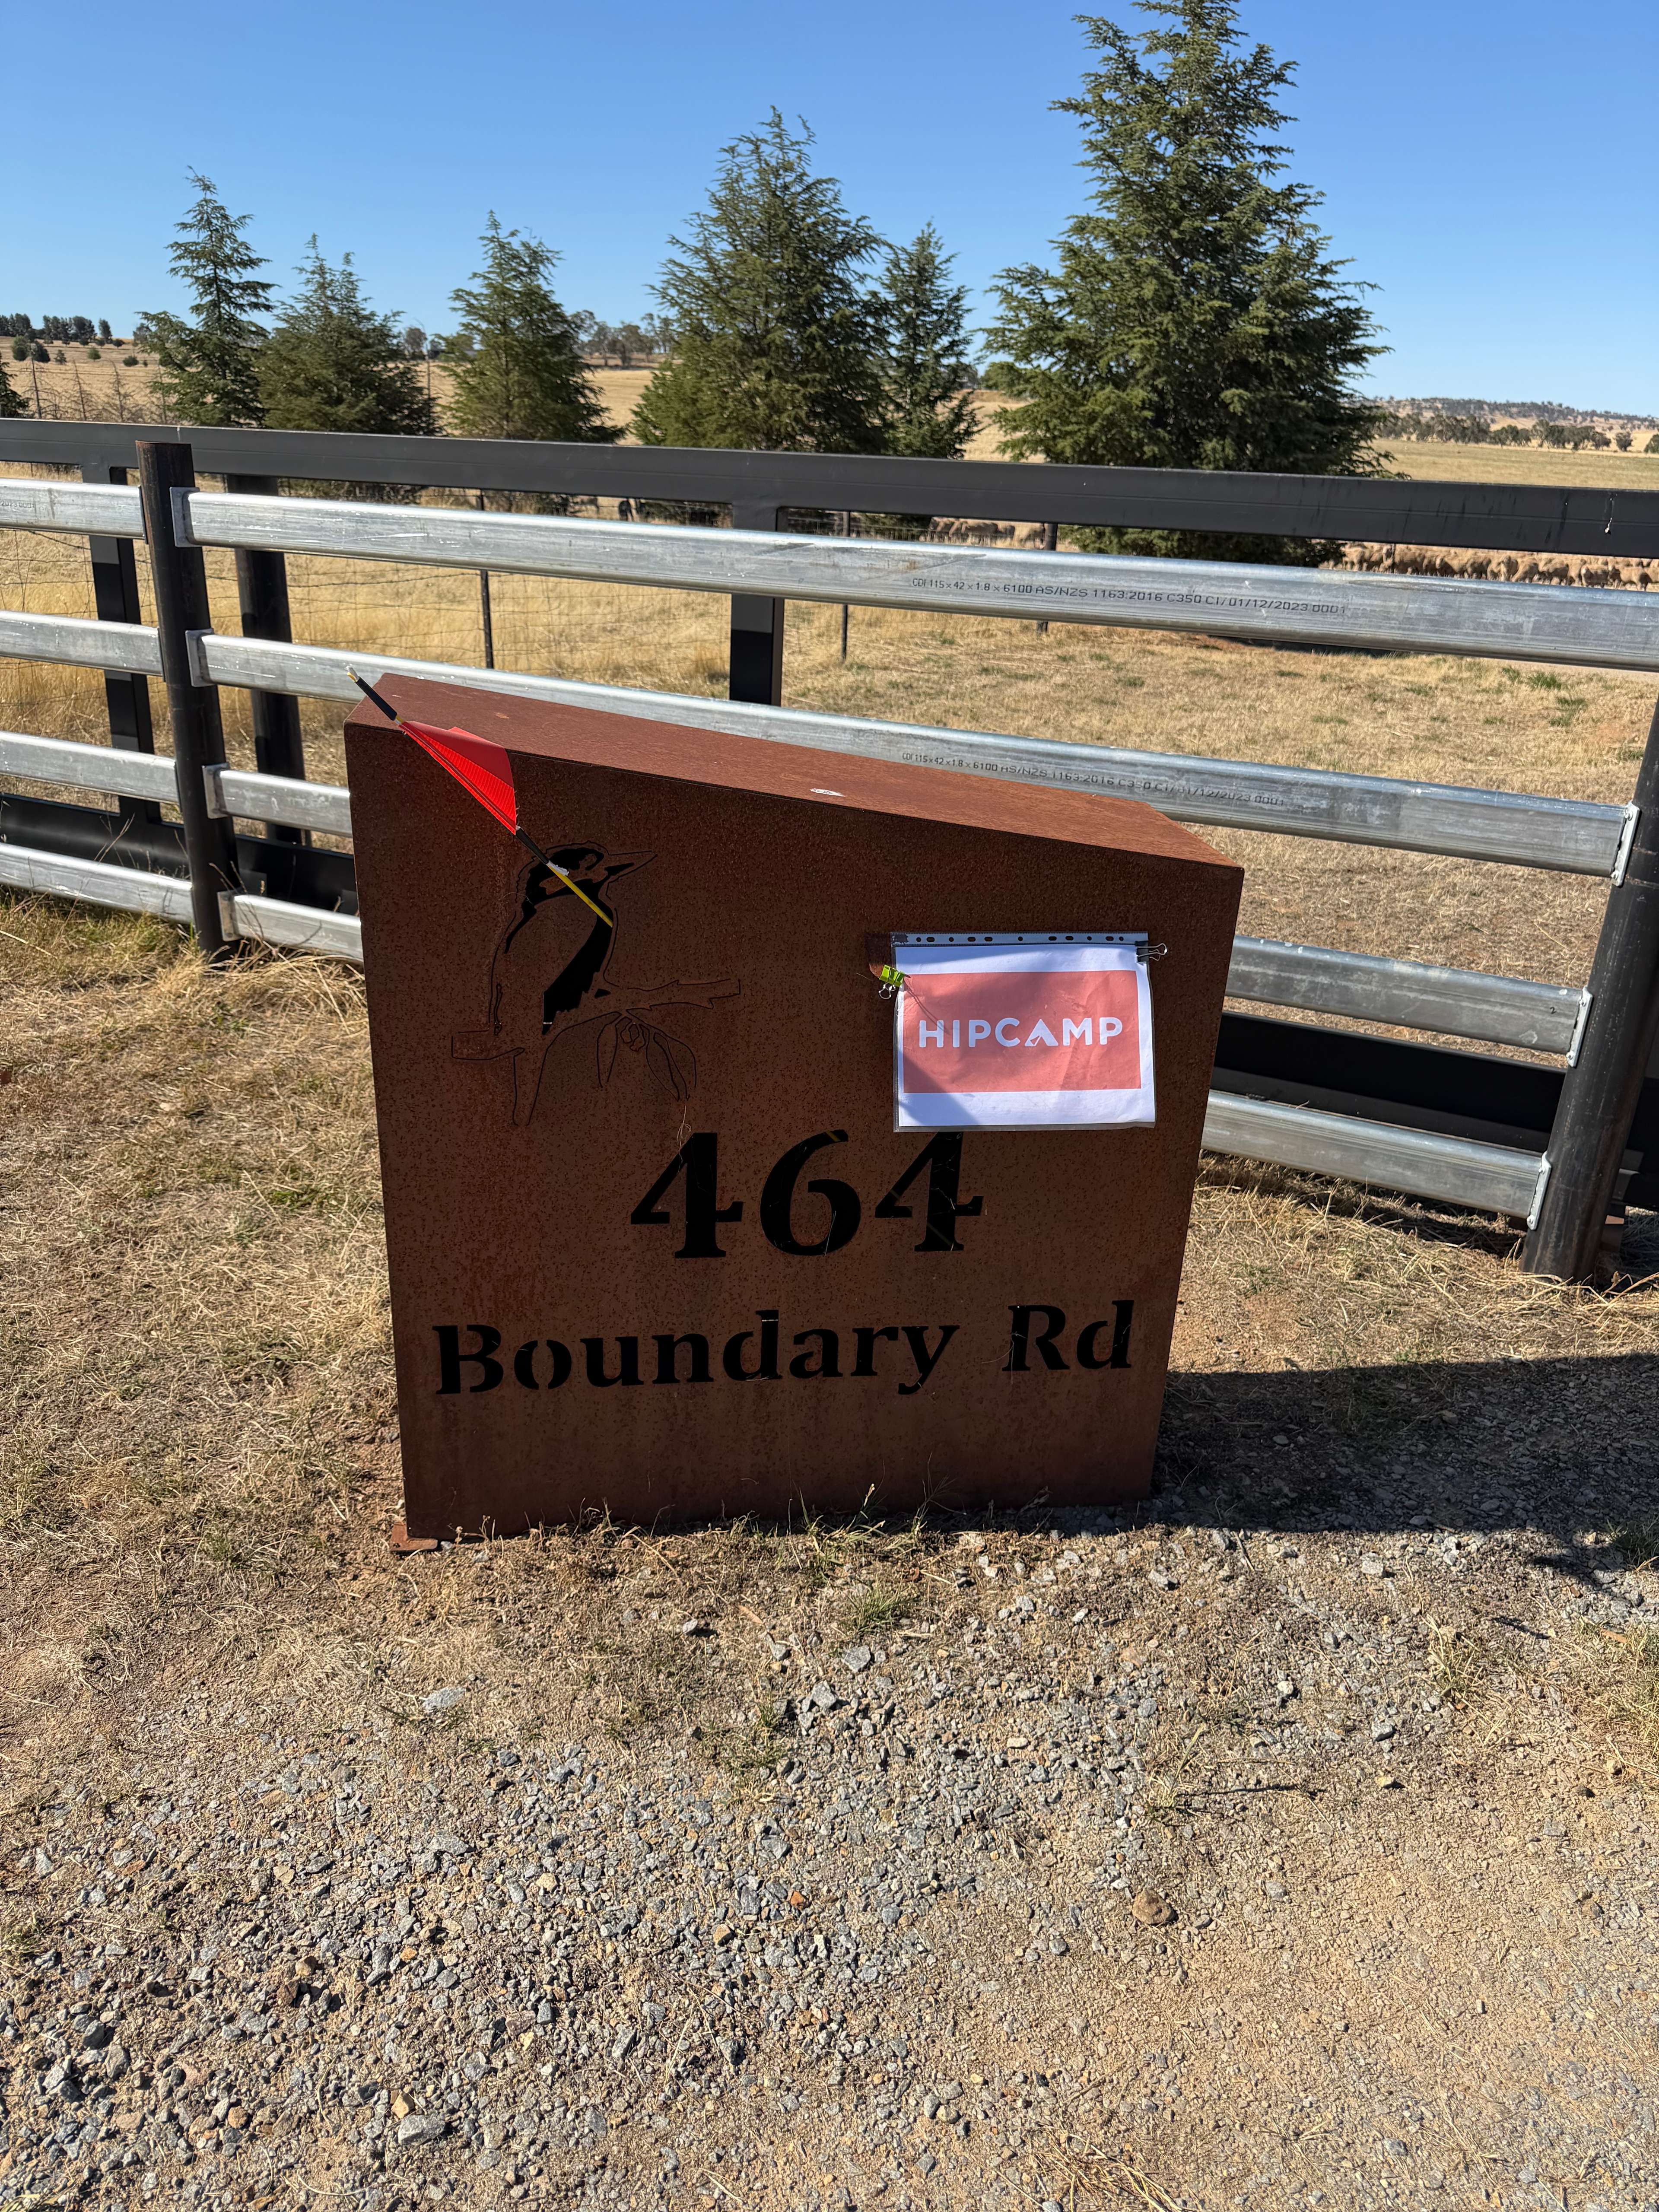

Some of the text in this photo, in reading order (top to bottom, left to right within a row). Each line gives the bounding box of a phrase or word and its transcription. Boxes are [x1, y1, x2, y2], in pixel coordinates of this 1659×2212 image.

[912, 578, 926, 587] CDI
[1036, 586, 1088, 597] AS/NZS
[1093, 589, 1162, 601] 1163:2016
[1167, 593, 1201, 604] C350
[1313, 604, 1345, 613] 0001
[1001, 765, 1047, 777] AS/NZS
[1053, 772, 1114, 785] 1163:2016
[919, 1017, 1123, 1048] HIPCAMP
[630, 1129, 984, 1259] 464
[432, 1300, 1135, 1395] Boundary Rd
